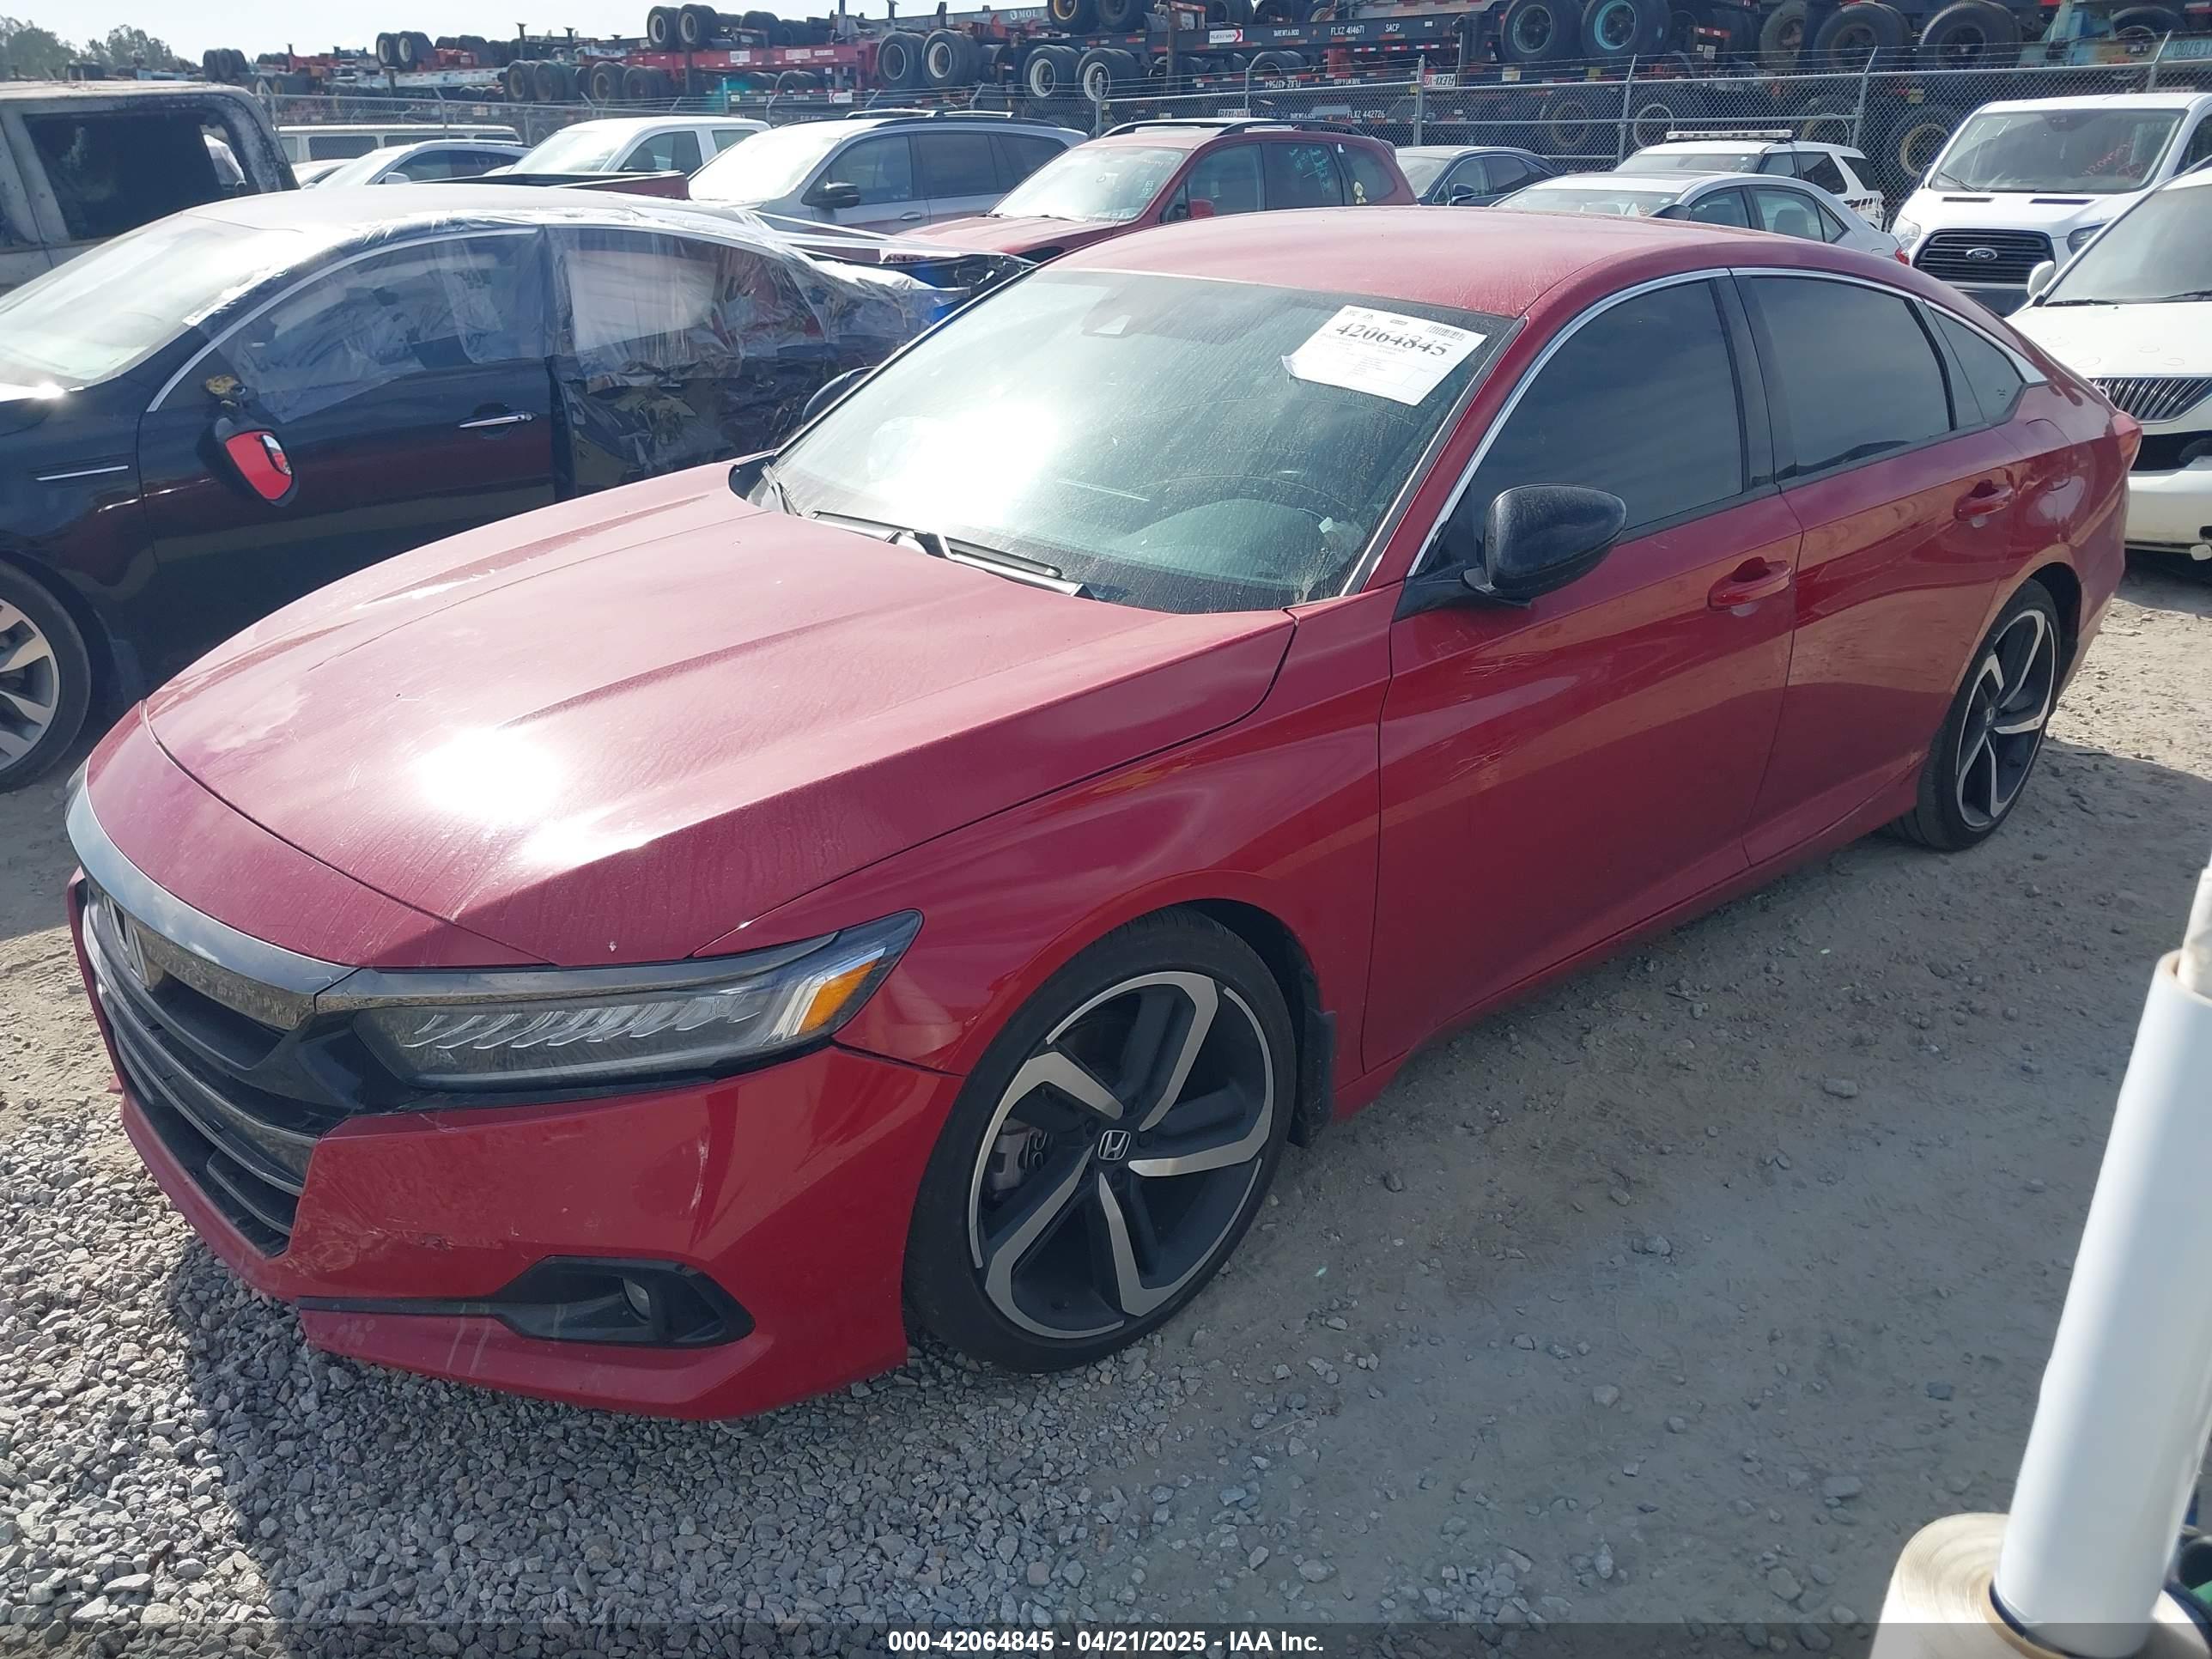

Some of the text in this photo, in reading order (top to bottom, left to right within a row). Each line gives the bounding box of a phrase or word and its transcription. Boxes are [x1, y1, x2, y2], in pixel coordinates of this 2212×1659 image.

[1330, 25, 1365, 36] FLXZ 414671
[1385, 23, 1401, 33] SACP
[1346, 109, 1385, 118] FLXZ 442726
[1336, 322, 1454, 357] 42064845
